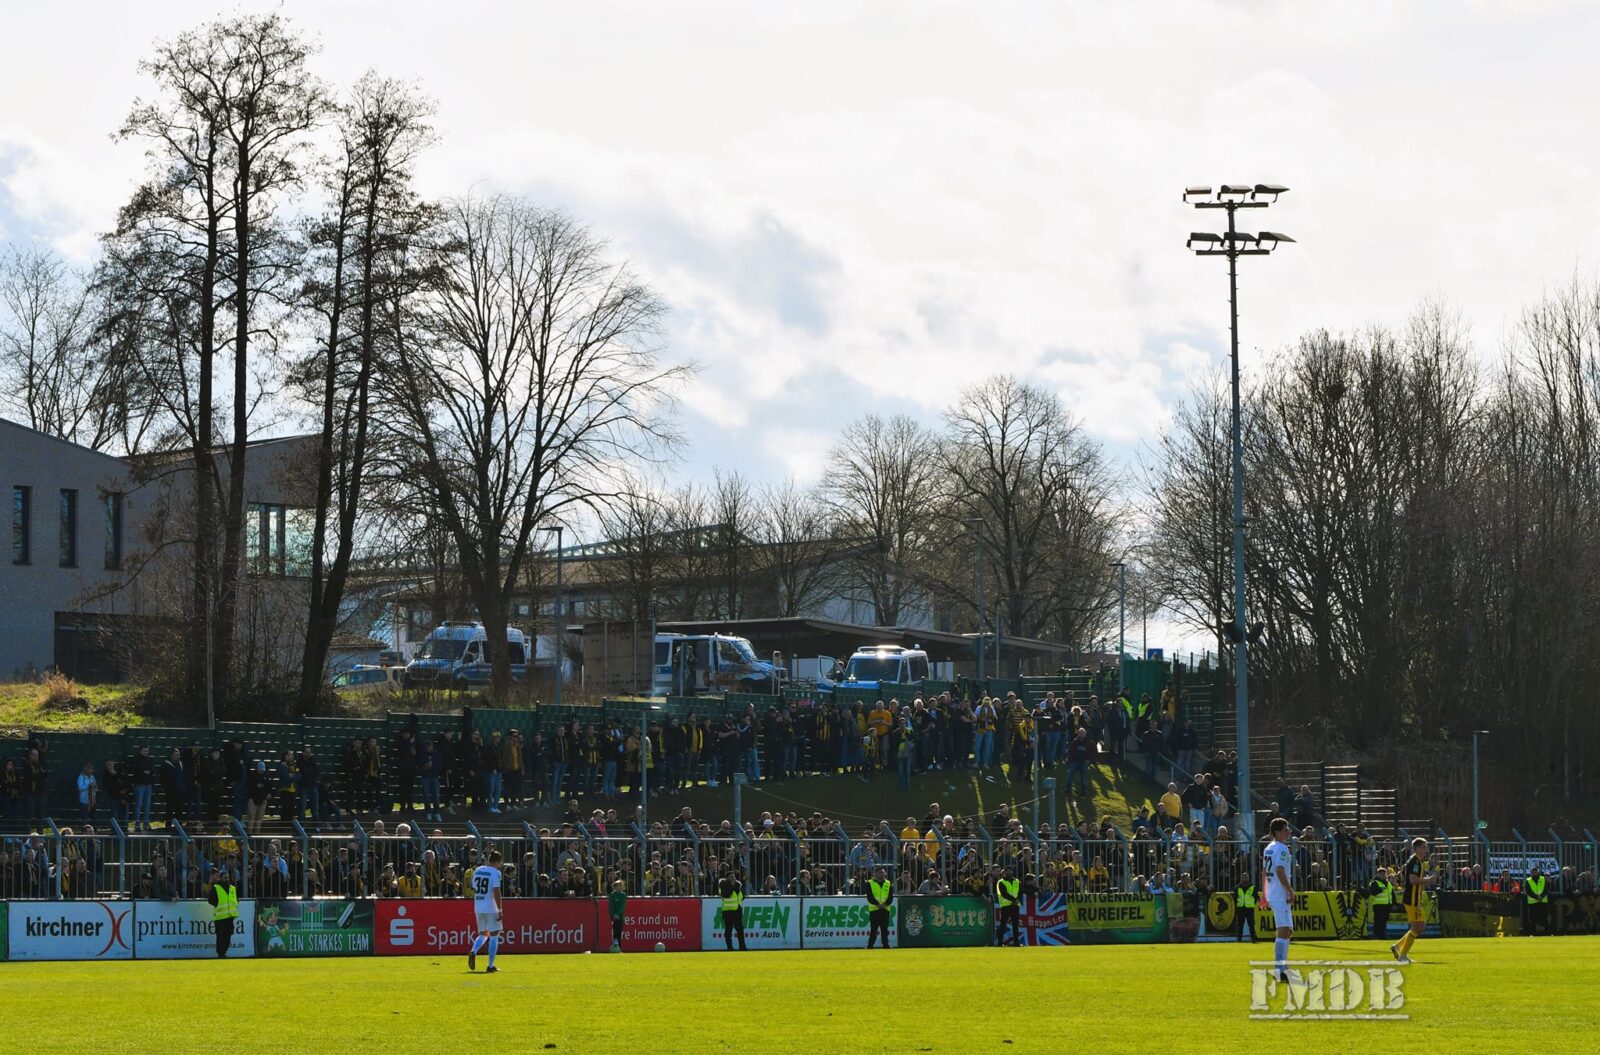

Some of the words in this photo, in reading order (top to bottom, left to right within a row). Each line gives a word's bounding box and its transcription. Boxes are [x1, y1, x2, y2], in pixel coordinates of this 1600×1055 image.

[474, 876, 489, 894] 39
[638, 914, 660, 925] rund
[664, 916, 678, 925] um
[714, 900, 790, 939] RIFEN
[806, 905, 896, 928] BRESSR
[930, 904, 986, 927] Barre
[1078, 906, 1144, 921] RUREIFEL
[26, 916, 103, 937] kirchner
[137, 915, 245, 941] print.mea
[635, 928, 685, 940] Immobilie.
[805, 930, 834, 938] Service
[289, 933, 304, 951] EIN
[308, 933, 343, 952] STARKES
[347, 933, 369, 951] TEAM
[427, 925, 515, 950] Sparkse
[521, 924, 583, 944] Herford
